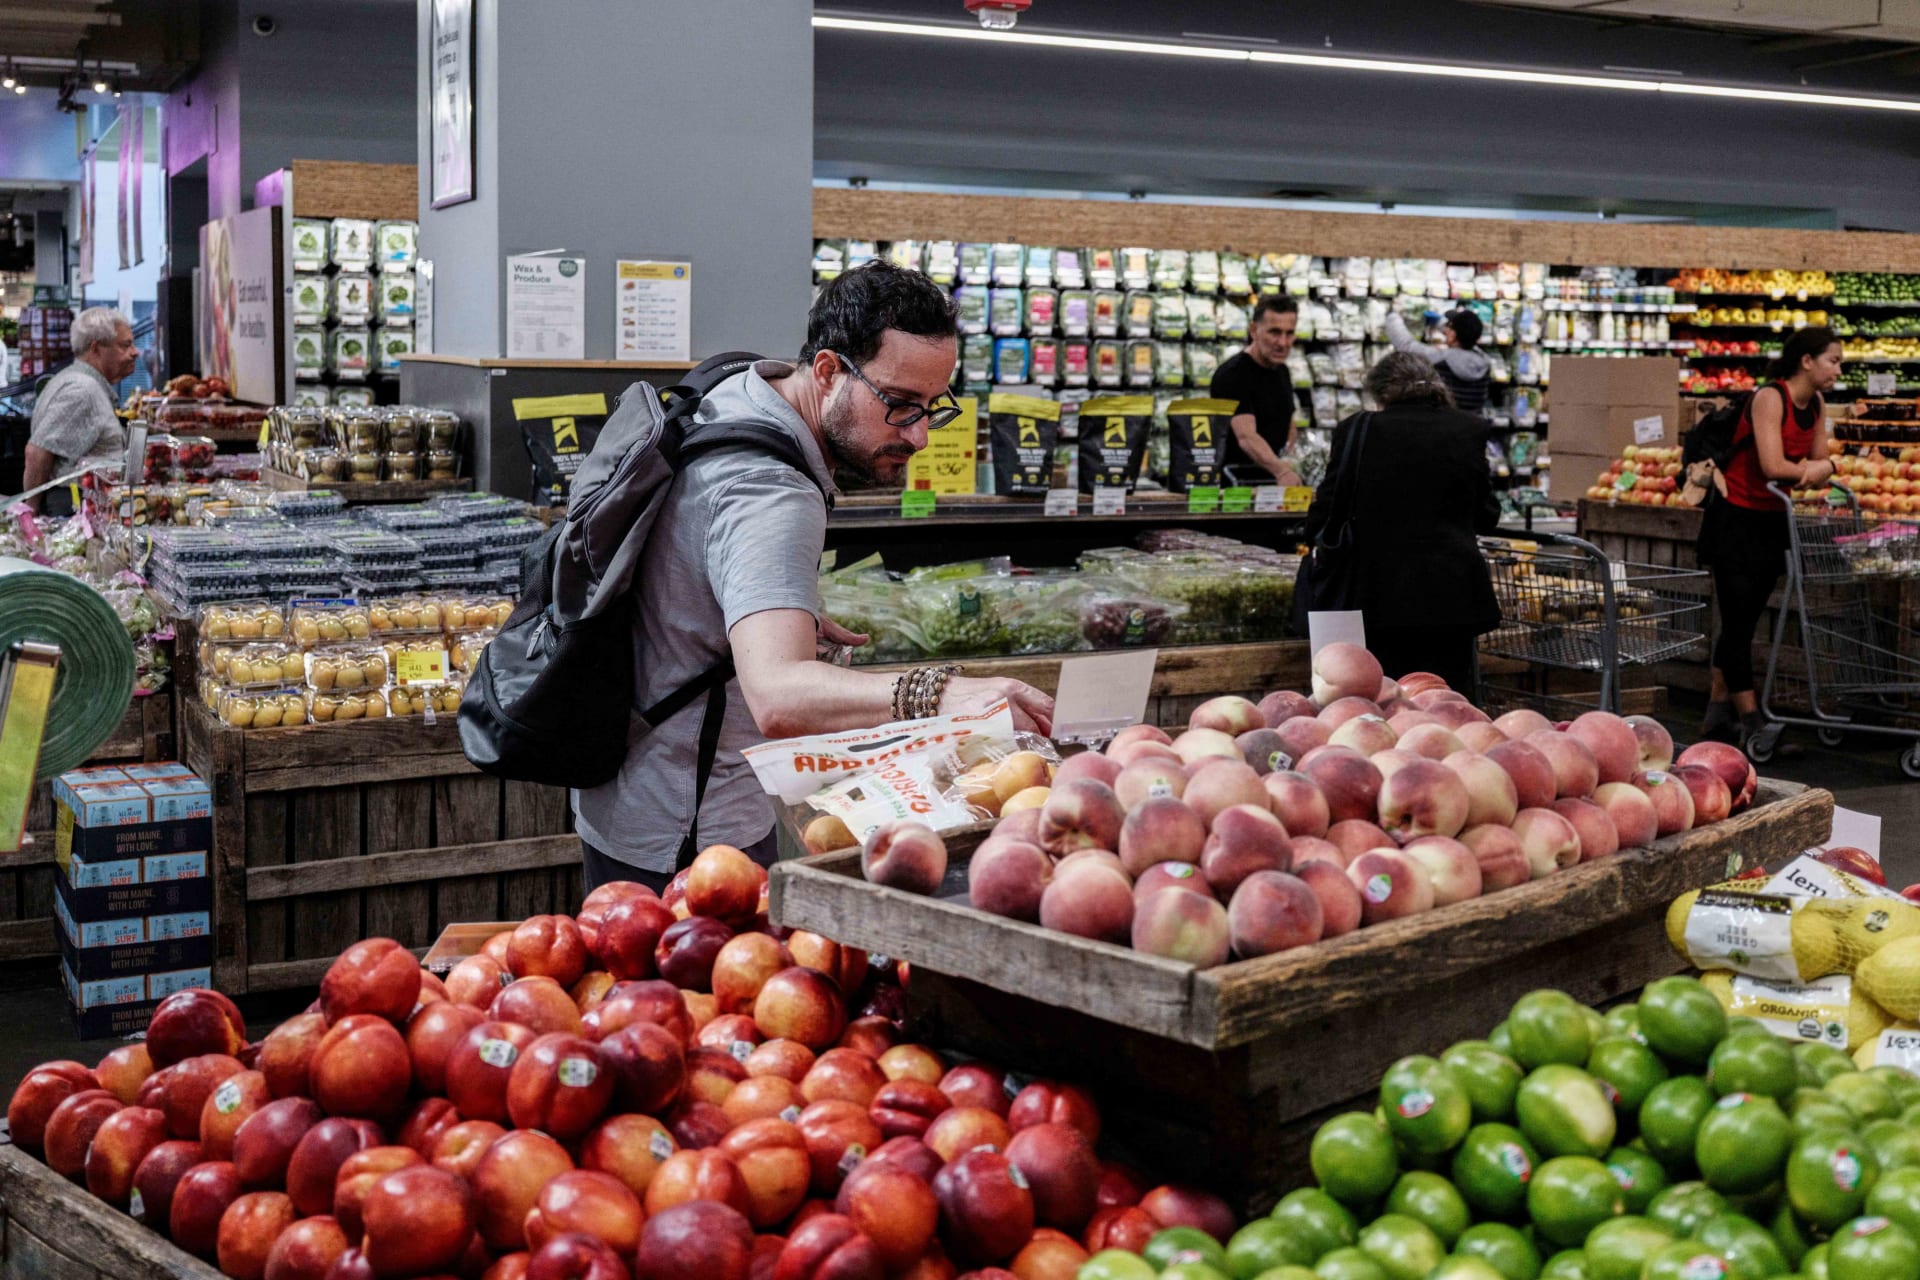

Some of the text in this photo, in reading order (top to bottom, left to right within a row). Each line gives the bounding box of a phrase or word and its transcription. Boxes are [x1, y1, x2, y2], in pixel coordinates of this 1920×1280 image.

[514, 264, 543, 273] Wax &
[514, 274, 551, 283] Produce
[116, 832, 136, 842] FROM
[117, 843, 135, 853] WITH
[108, 891, 129, 900] FROM
[108, 901, 127, 911] WITH
[182, 928, 203, 936] SURF
[115, 935, 137, 944] SURF
[1717, 933, 1758, 948] GREEN
[112, 949, 131, 959] FROM
[112, 959, 130, 969] WITH
[1760, 1003, 1819, 1018] ORGANIC
